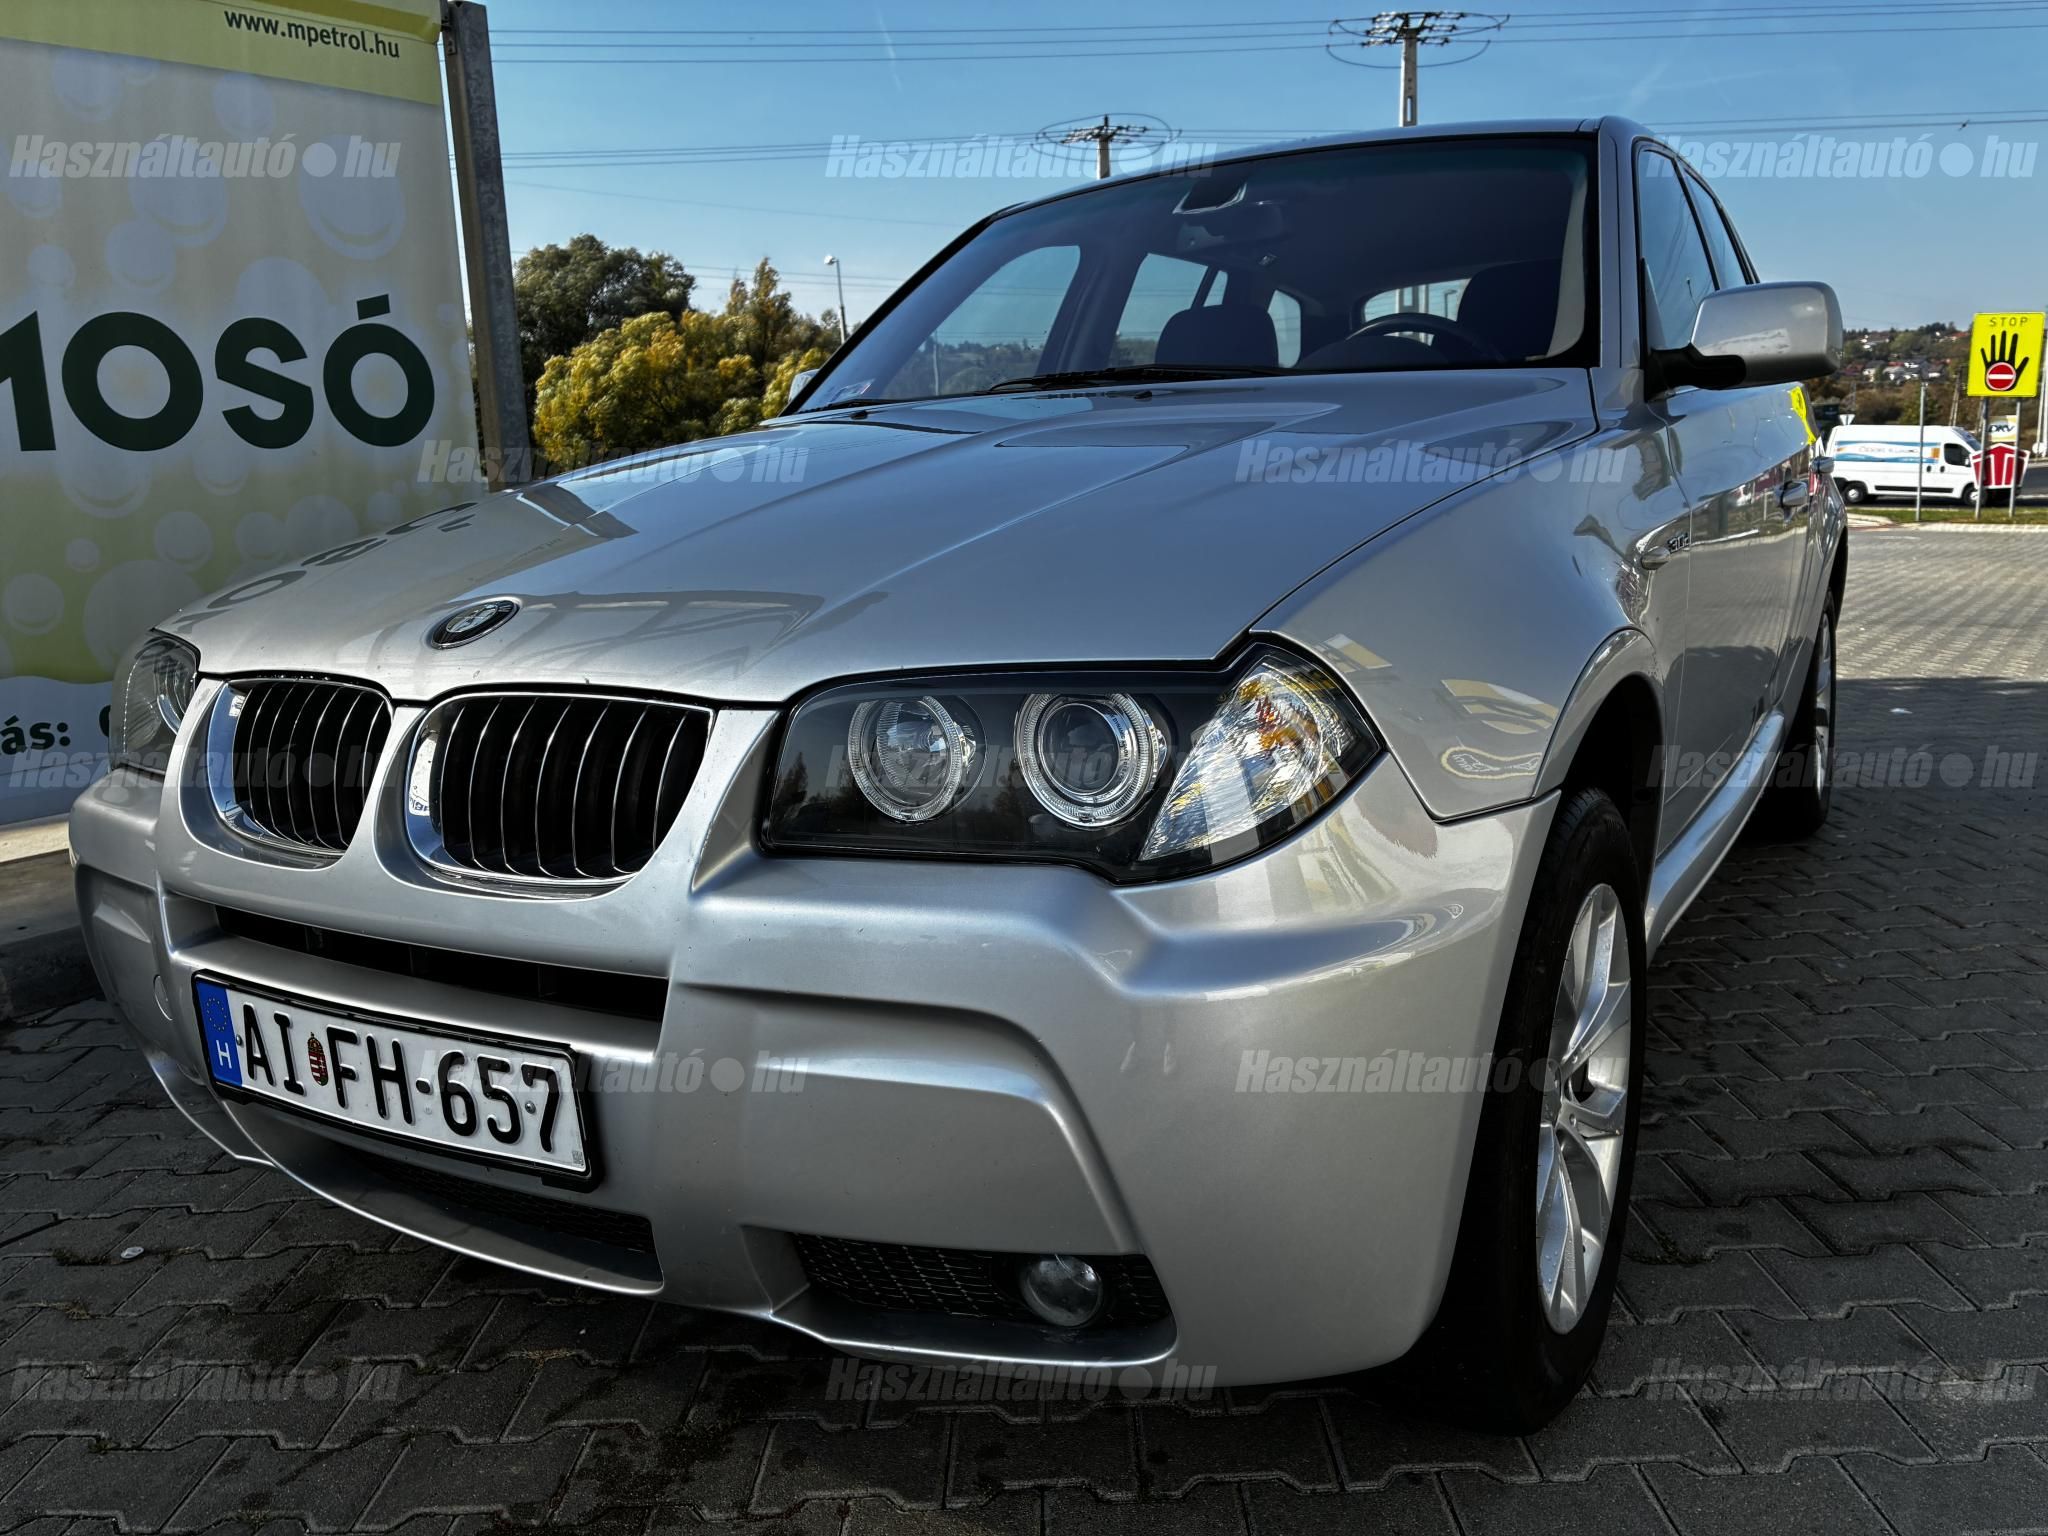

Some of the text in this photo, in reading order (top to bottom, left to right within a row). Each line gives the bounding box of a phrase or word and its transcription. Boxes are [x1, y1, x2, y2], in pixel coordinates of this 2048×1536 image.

[224, 10, 401, 58] www.mpetrol.hu
[1989, 316, 2028, 327] STOP
[216, 1040, 233, 1070] H
[243, 1002, 562, 1153] AI FH-657
